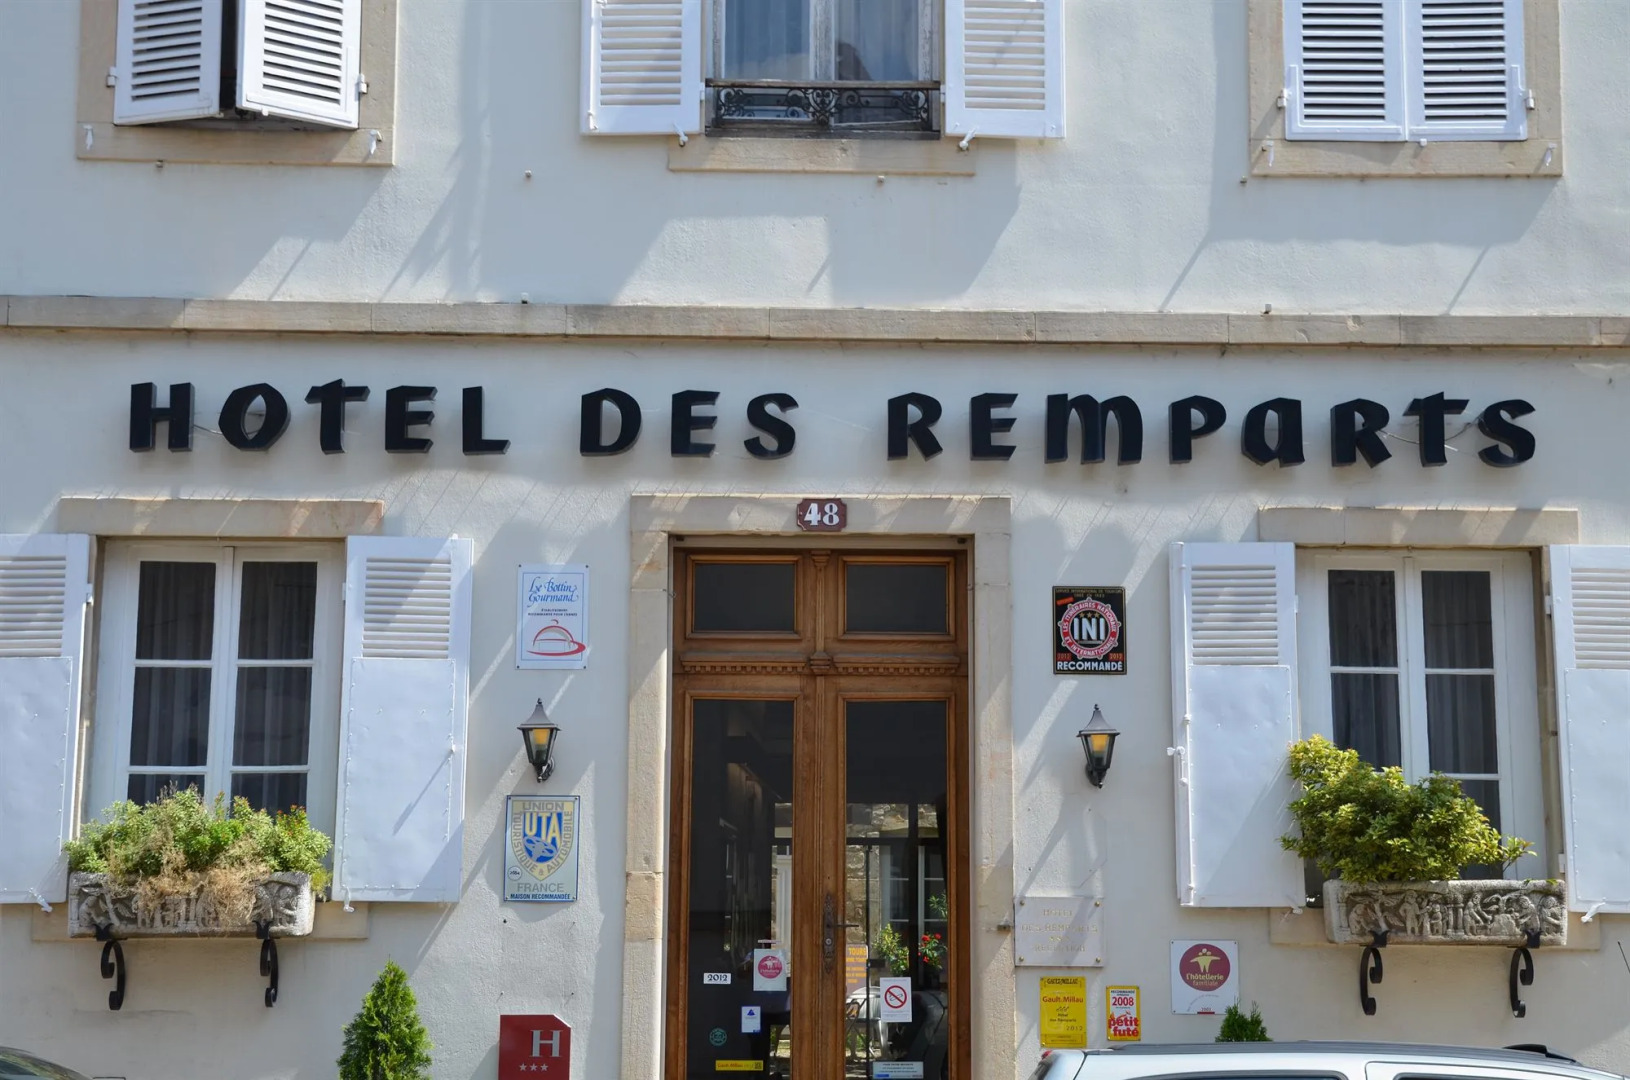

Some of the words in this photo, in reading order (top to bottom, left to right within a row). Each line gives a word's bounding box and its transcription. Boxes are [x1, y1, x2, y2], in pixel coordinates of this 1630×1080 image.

[129, 379, 510, 456] HOTEL
[579, 387, 799, 459] DES
[803, 502, 840, 526] 48
[528, 576, 542, 592] Le
[544, 577, 578, 592] Bottin
[527, 591, 579, 608] Gourmand
[1073, 617, 1106, 641] INI
[1056, 661, 1123, 670] RECOMMANDÉ
[522, 802, 564, 811] UNION
[524, 812, 561, 850] UTA
[512, 811, 539, 874] TOURISTIQUE
[546, 811, 573, 874] AUTOMOBILE
[517, 882, 565, 893] FRANCE
[1112, 996, 1134, 1007] 2008
[1108, 1016, 1139, 1028] petit
[1112, 1026, 1139, 1037] futé
[529, 1030, 563, 1057] H
